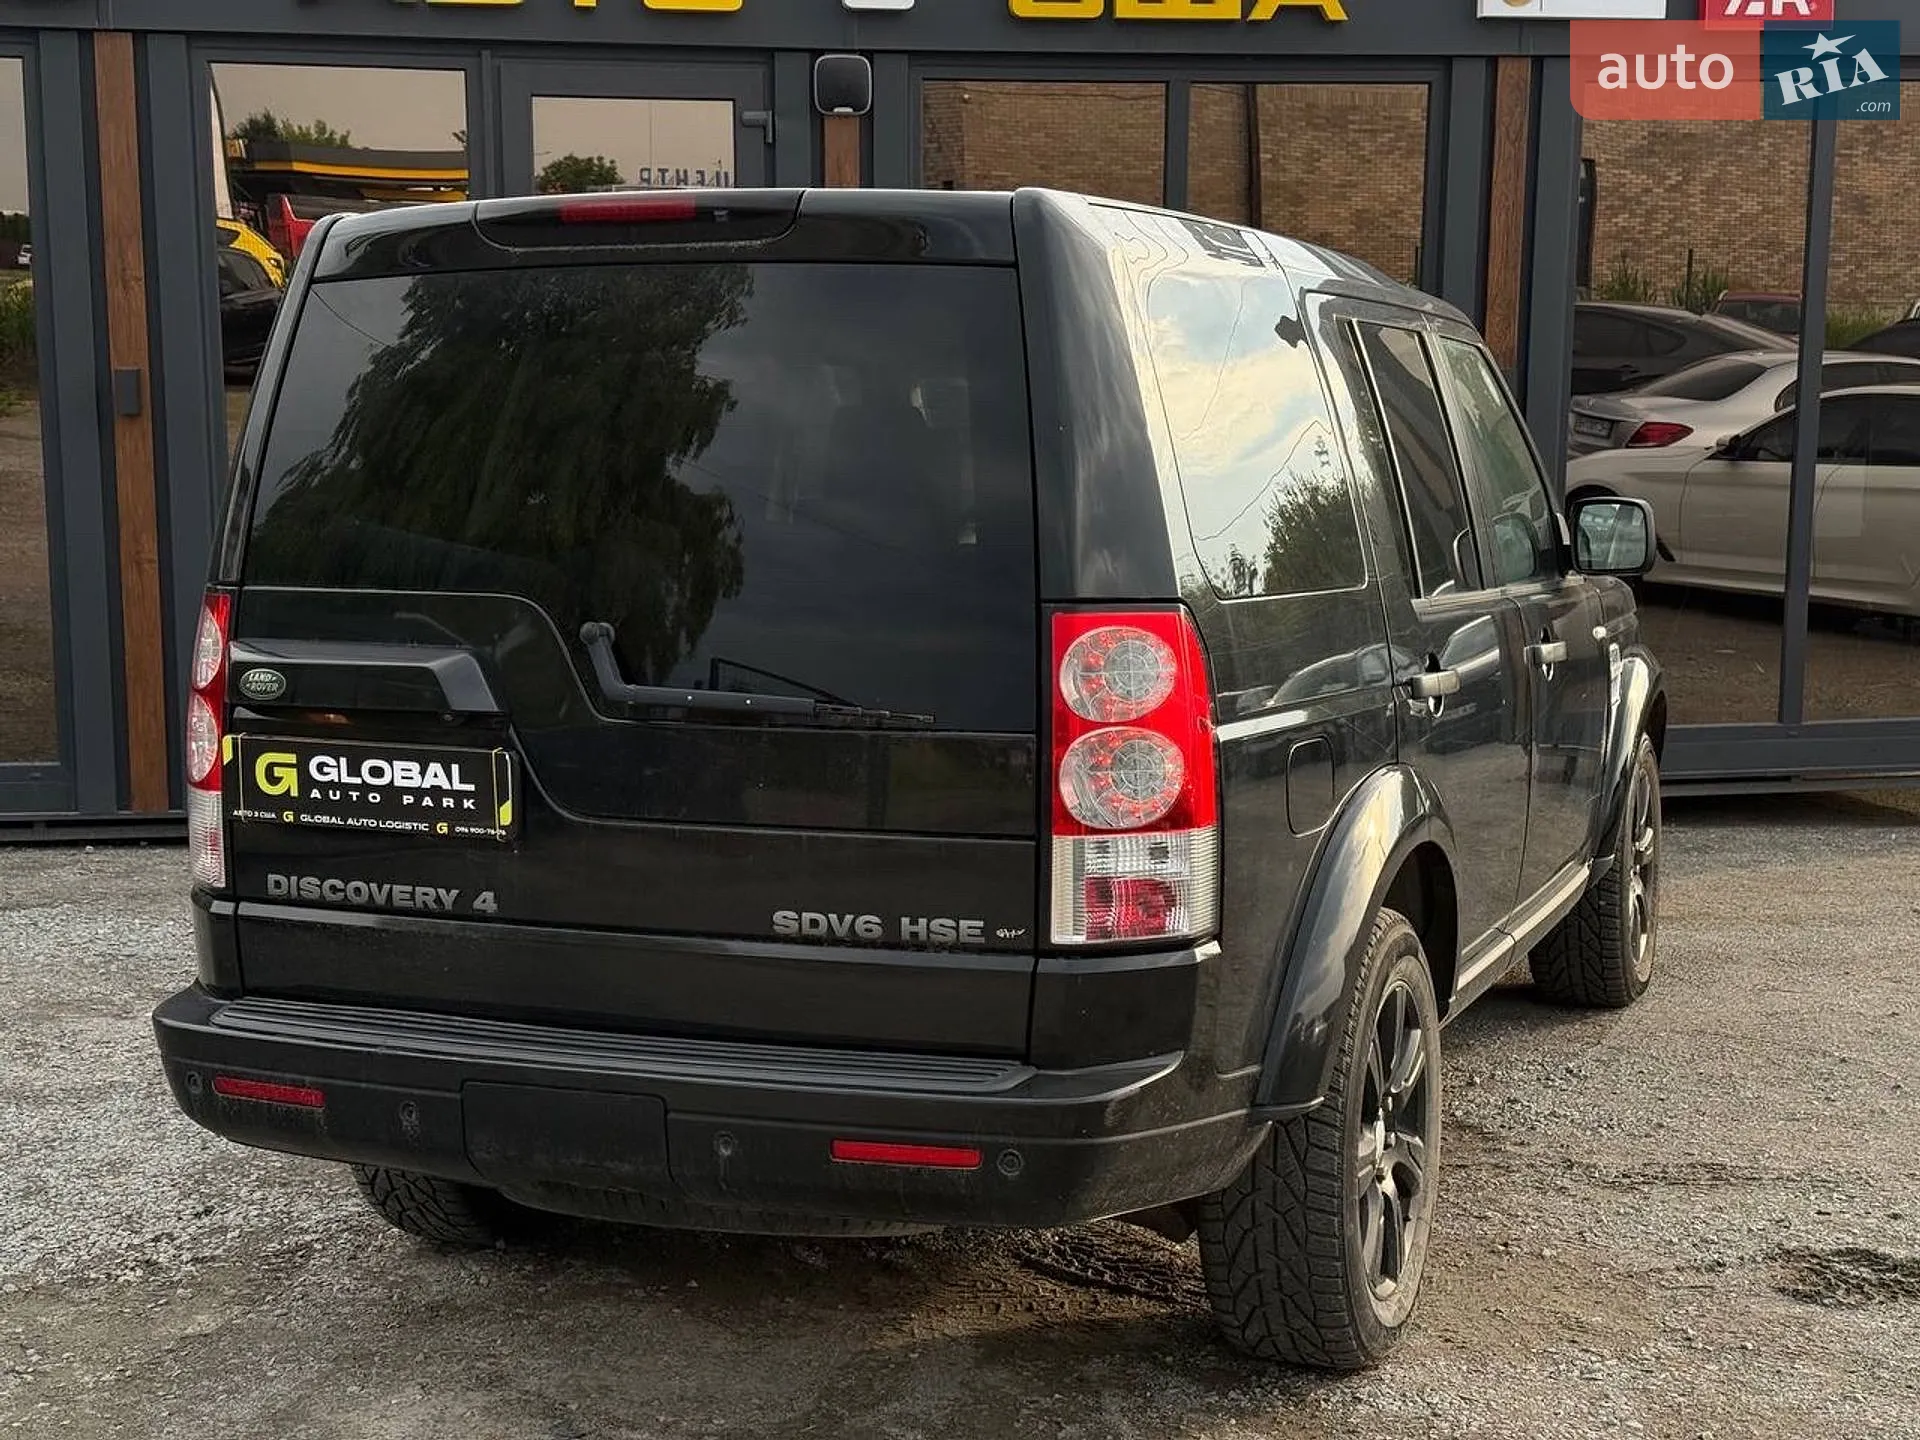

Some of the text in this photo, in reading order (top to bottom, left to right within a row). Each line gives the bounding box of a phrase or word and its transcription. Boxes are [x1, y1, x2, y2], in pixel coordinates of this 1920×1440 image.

[248, 672, 273, 682] LAND
[250, 682, 279, 692] ROVER
[308, 755, 475, 792] GLOBAL
[309, 788, 476, 810] AUTO PARK
[300, 814, 345, 825] GLOBAL
[346, 817, 378, 828] AUTO
[379, 819, 430, 831] LOGISTIC
[267, 873, 498, 914] DISCOVERY 4
[772, 910, 985, 944] SDV6 HSE
